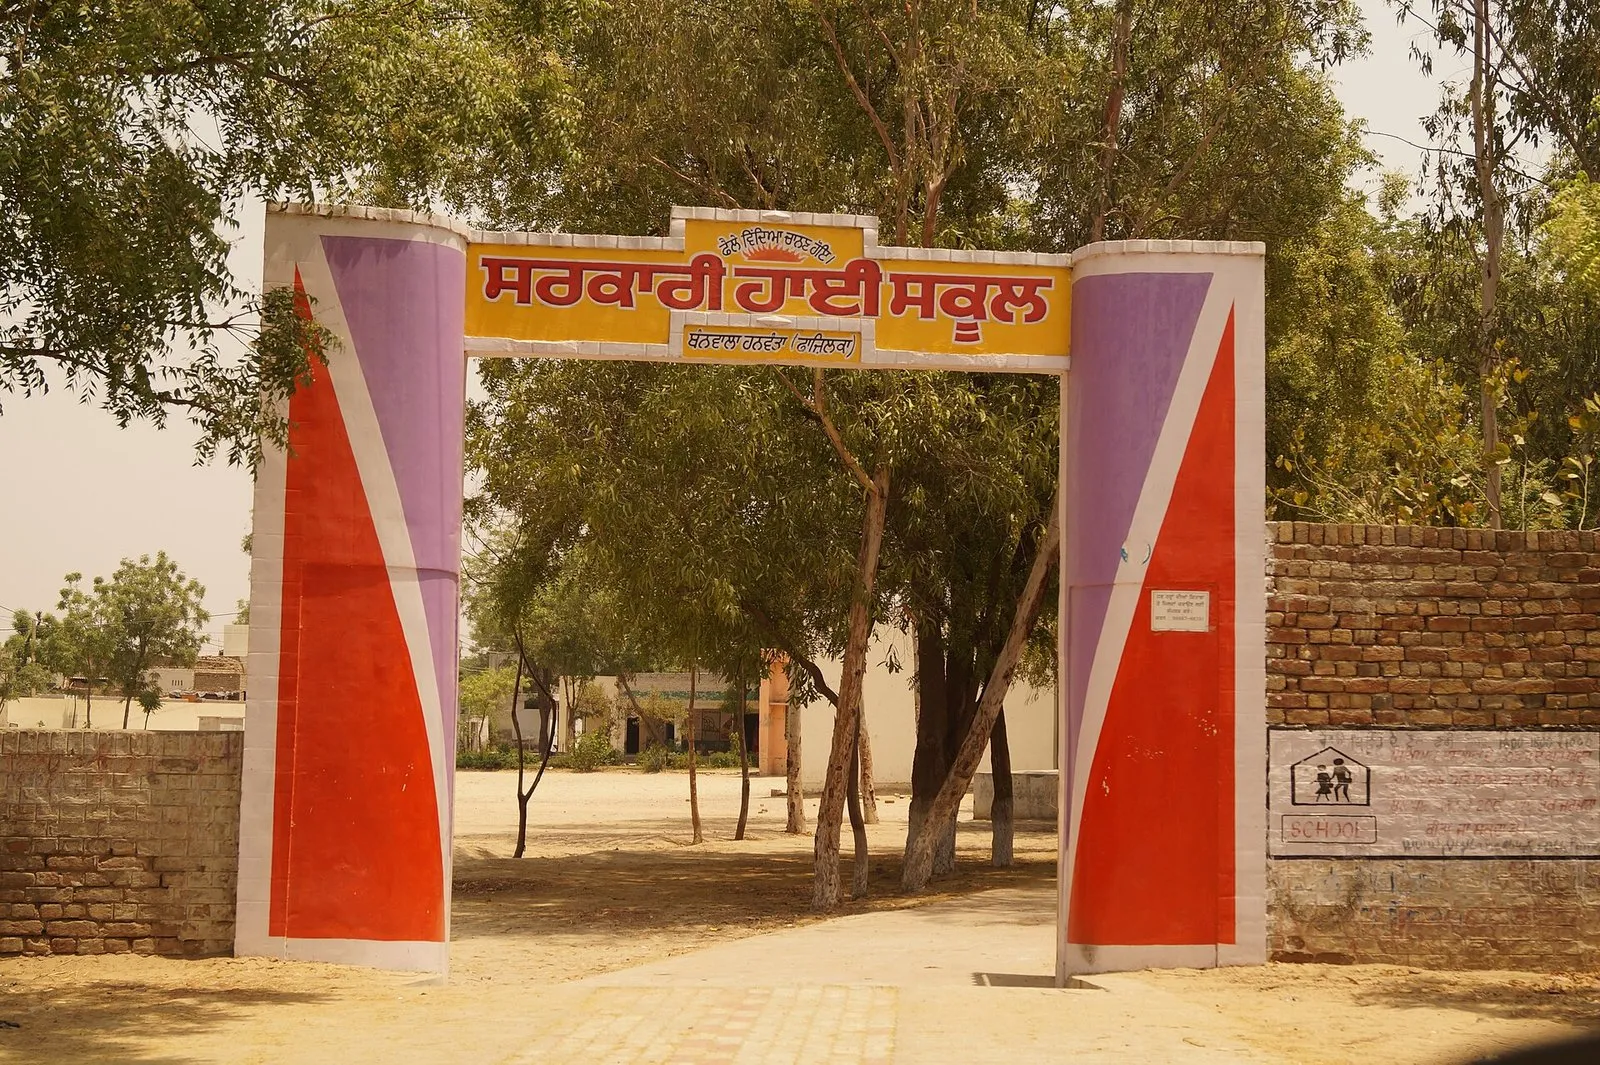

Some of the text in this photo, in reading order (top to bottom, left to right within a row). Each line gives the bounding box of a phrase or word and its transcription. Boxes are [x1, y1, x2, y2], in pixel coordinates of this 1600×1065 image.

[480, 253, 1053, 343] ਸਰਕਾਰੀ ਹਾਈ ਸਕੂਲ
[1290, 820, 1365, 839] SCHOOL
